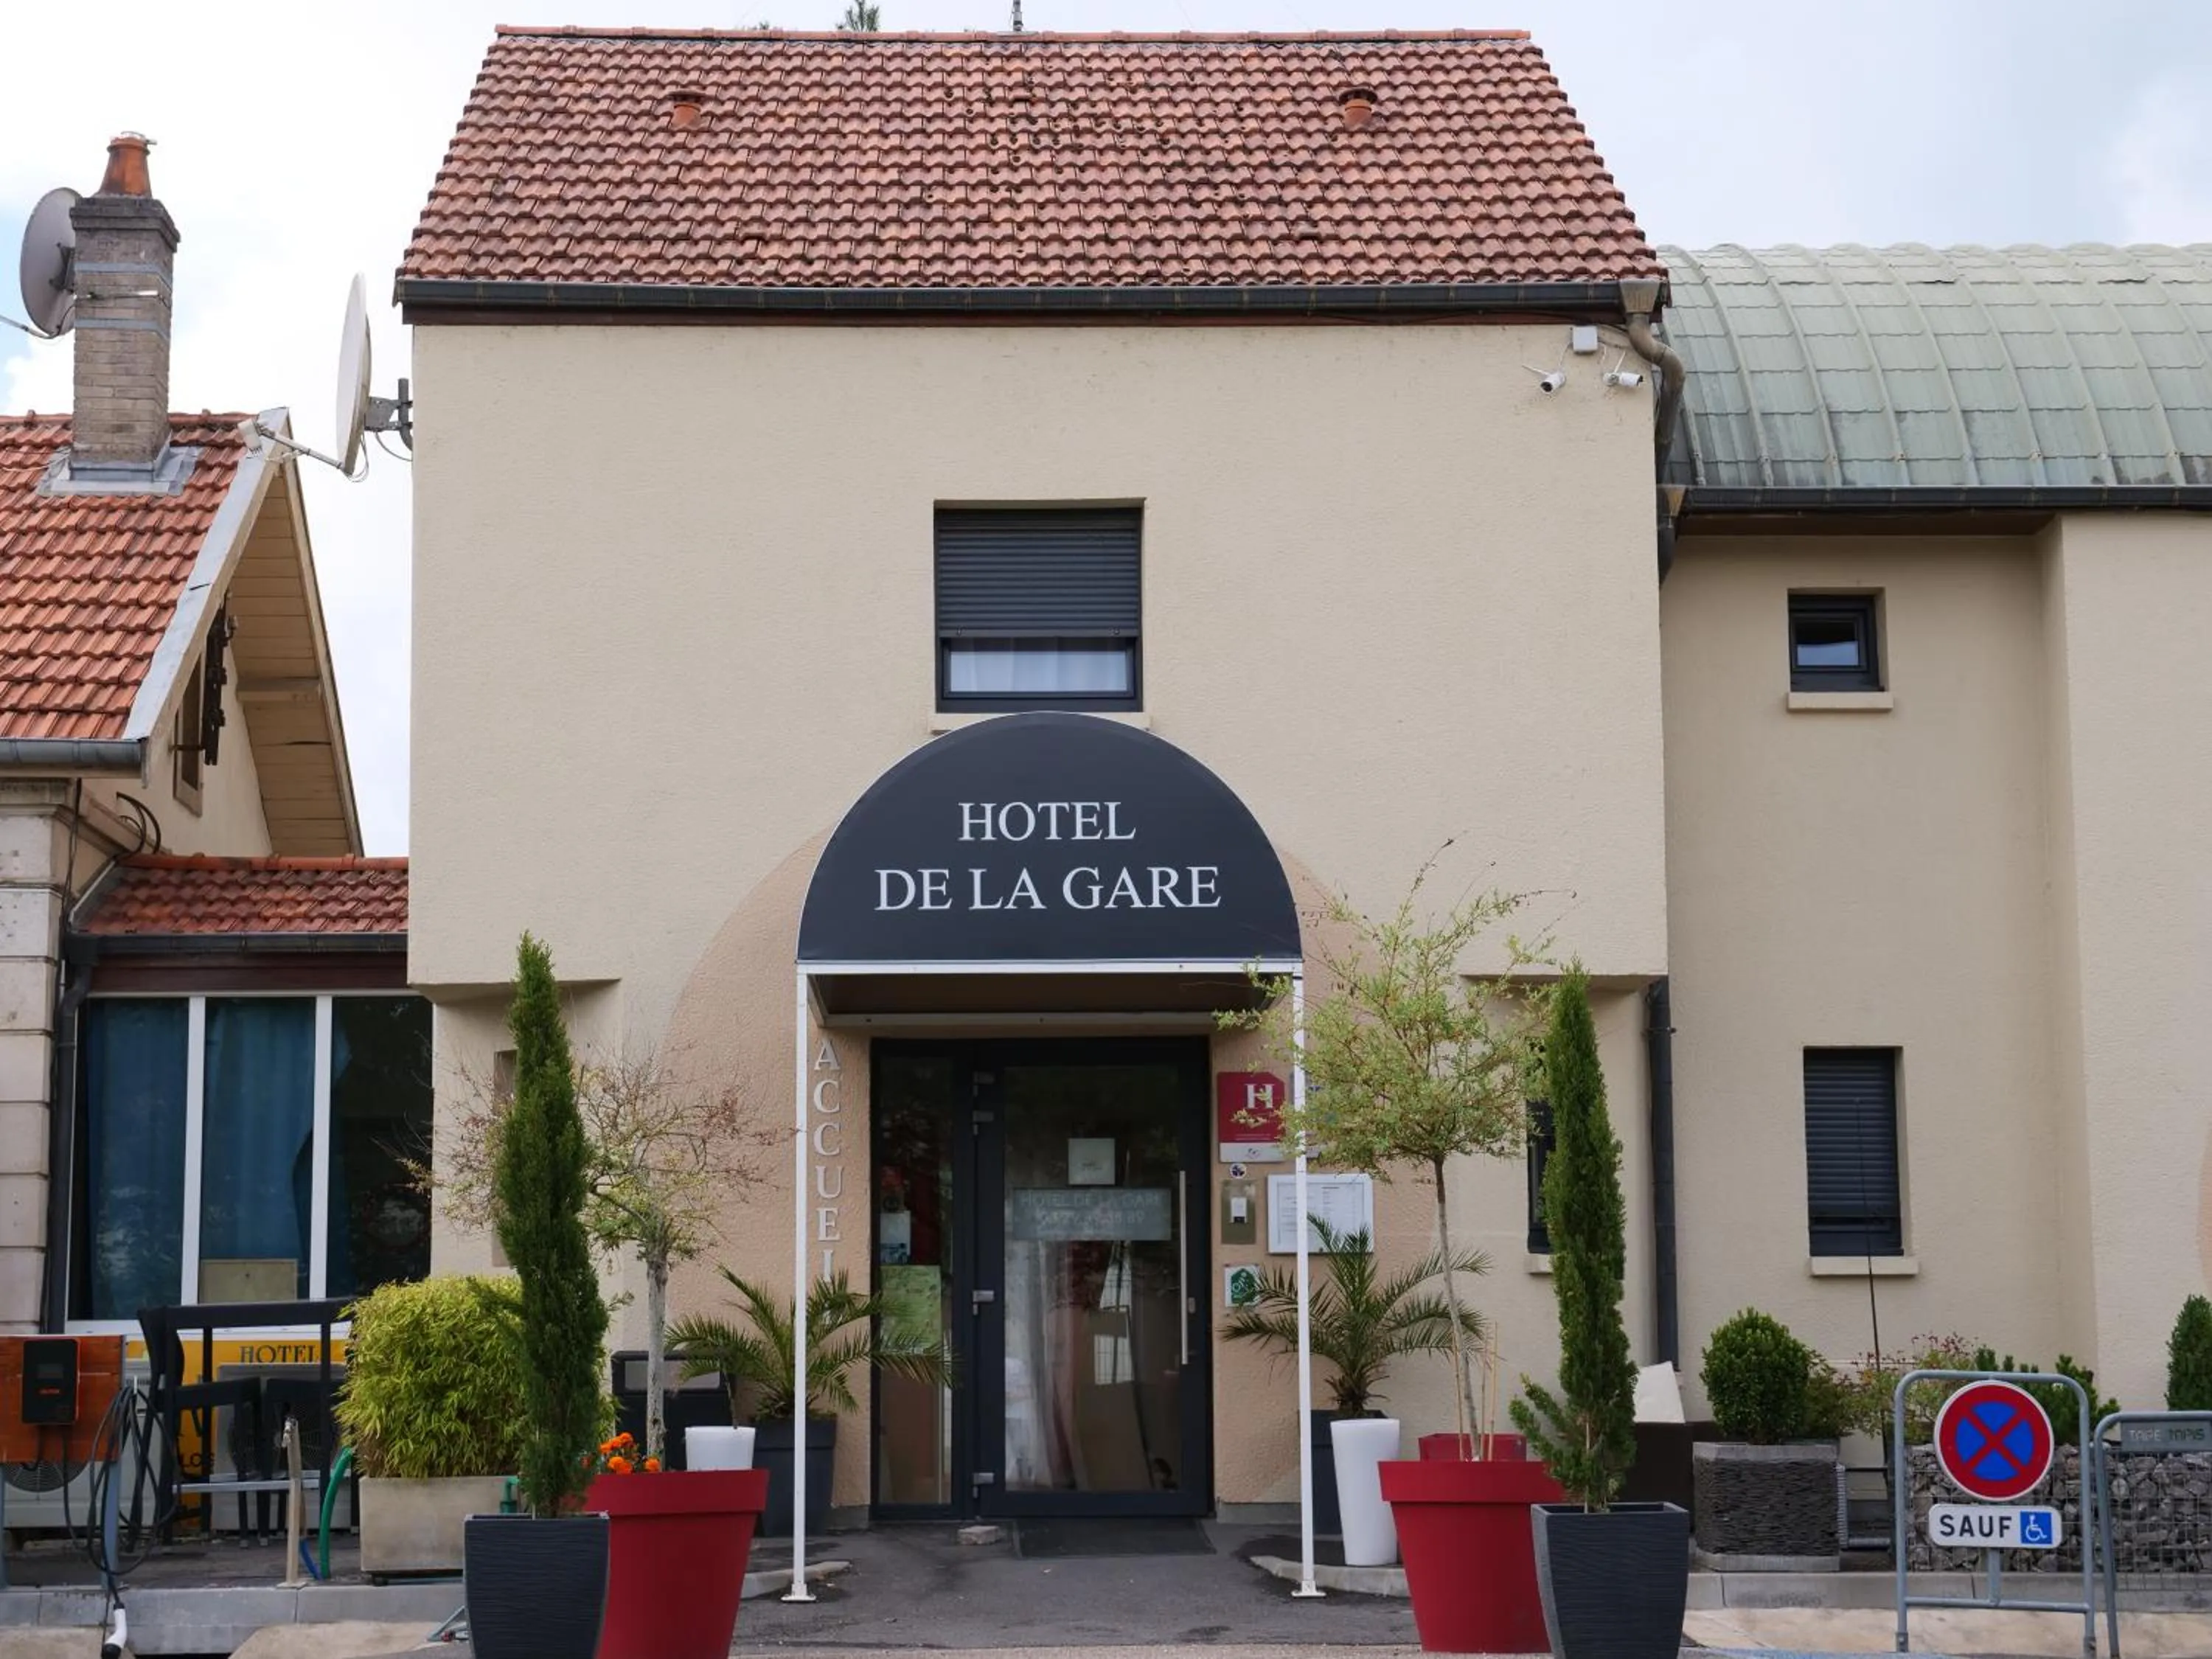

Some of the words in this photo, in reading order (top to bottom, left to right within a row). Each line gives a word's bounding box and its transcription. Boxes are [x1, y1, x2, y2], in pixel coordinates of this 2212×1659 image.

[959, 801, 1136, 841] HOTEL
[874, 868, 953, 911] DE
[968, 867, 1047, 911] LA
[1062, 866, 1222, 910] GARE
[813, 1037, 844, 1318] ACCUEI
[239, 1344, 321, 1363] HOTEL
[1939, 1514, 2012, 1539] SAUF
